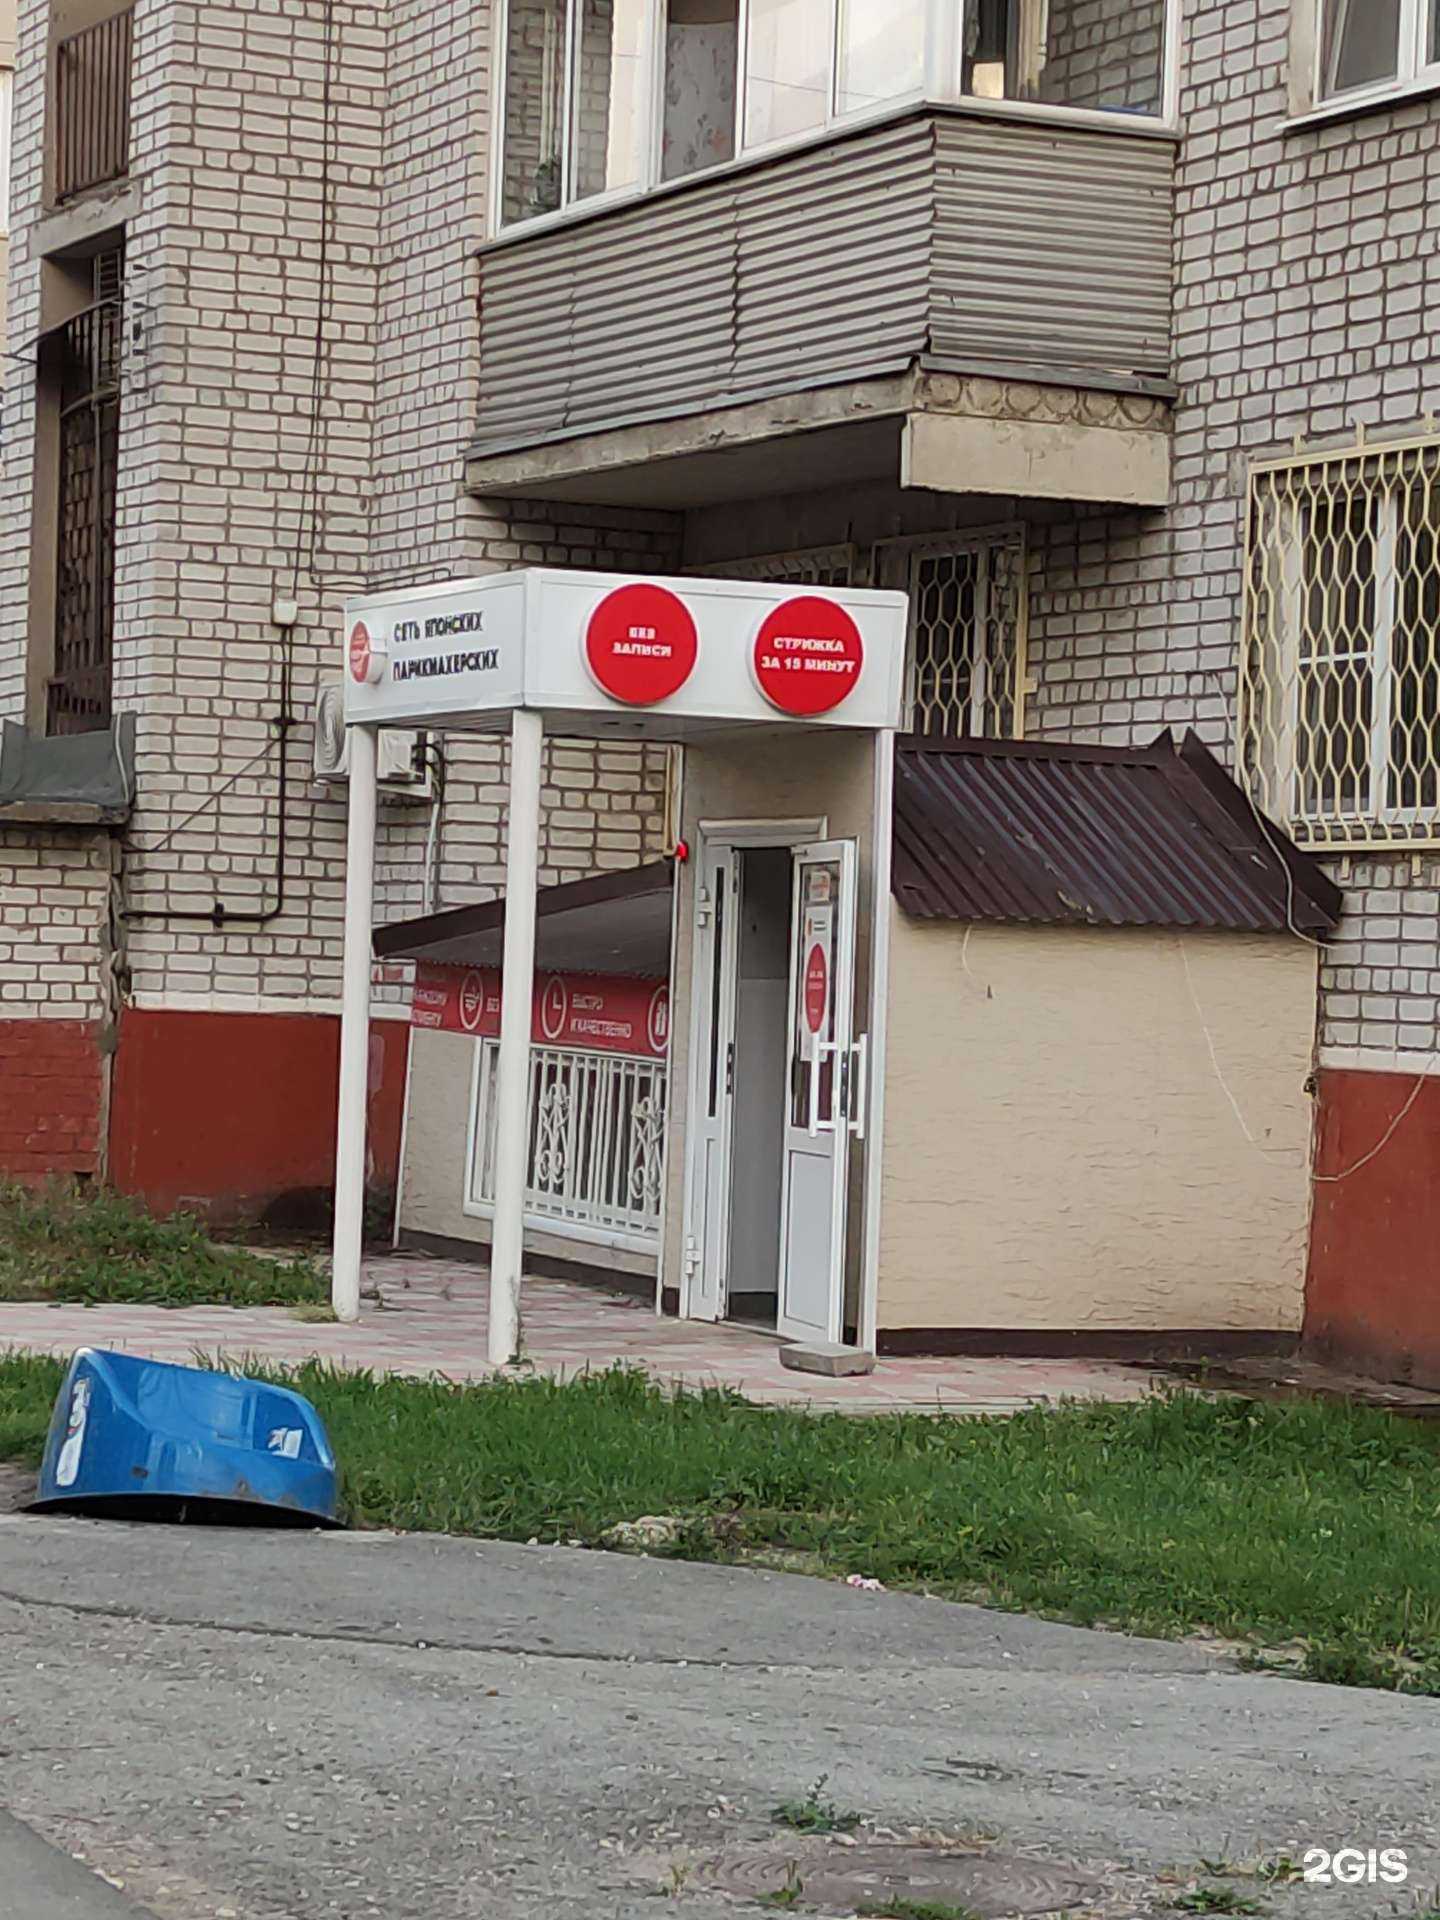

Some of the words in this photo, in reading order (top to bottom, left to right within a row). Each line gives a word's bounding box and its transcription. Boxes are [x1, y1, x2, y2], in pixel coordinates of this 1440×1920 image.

[394, 620, 420, 642] СЕТЬ
[613, 642, 671, 657] ЗАПИСИ
[773, 637, 844, 652] СТРИЖКА
[393, 649, 499, 681] ПАРИКМАХЕРСКИХ
[761, 656, 780, 669] ЗА
[804, 658, 855, 673] МИНУТ
